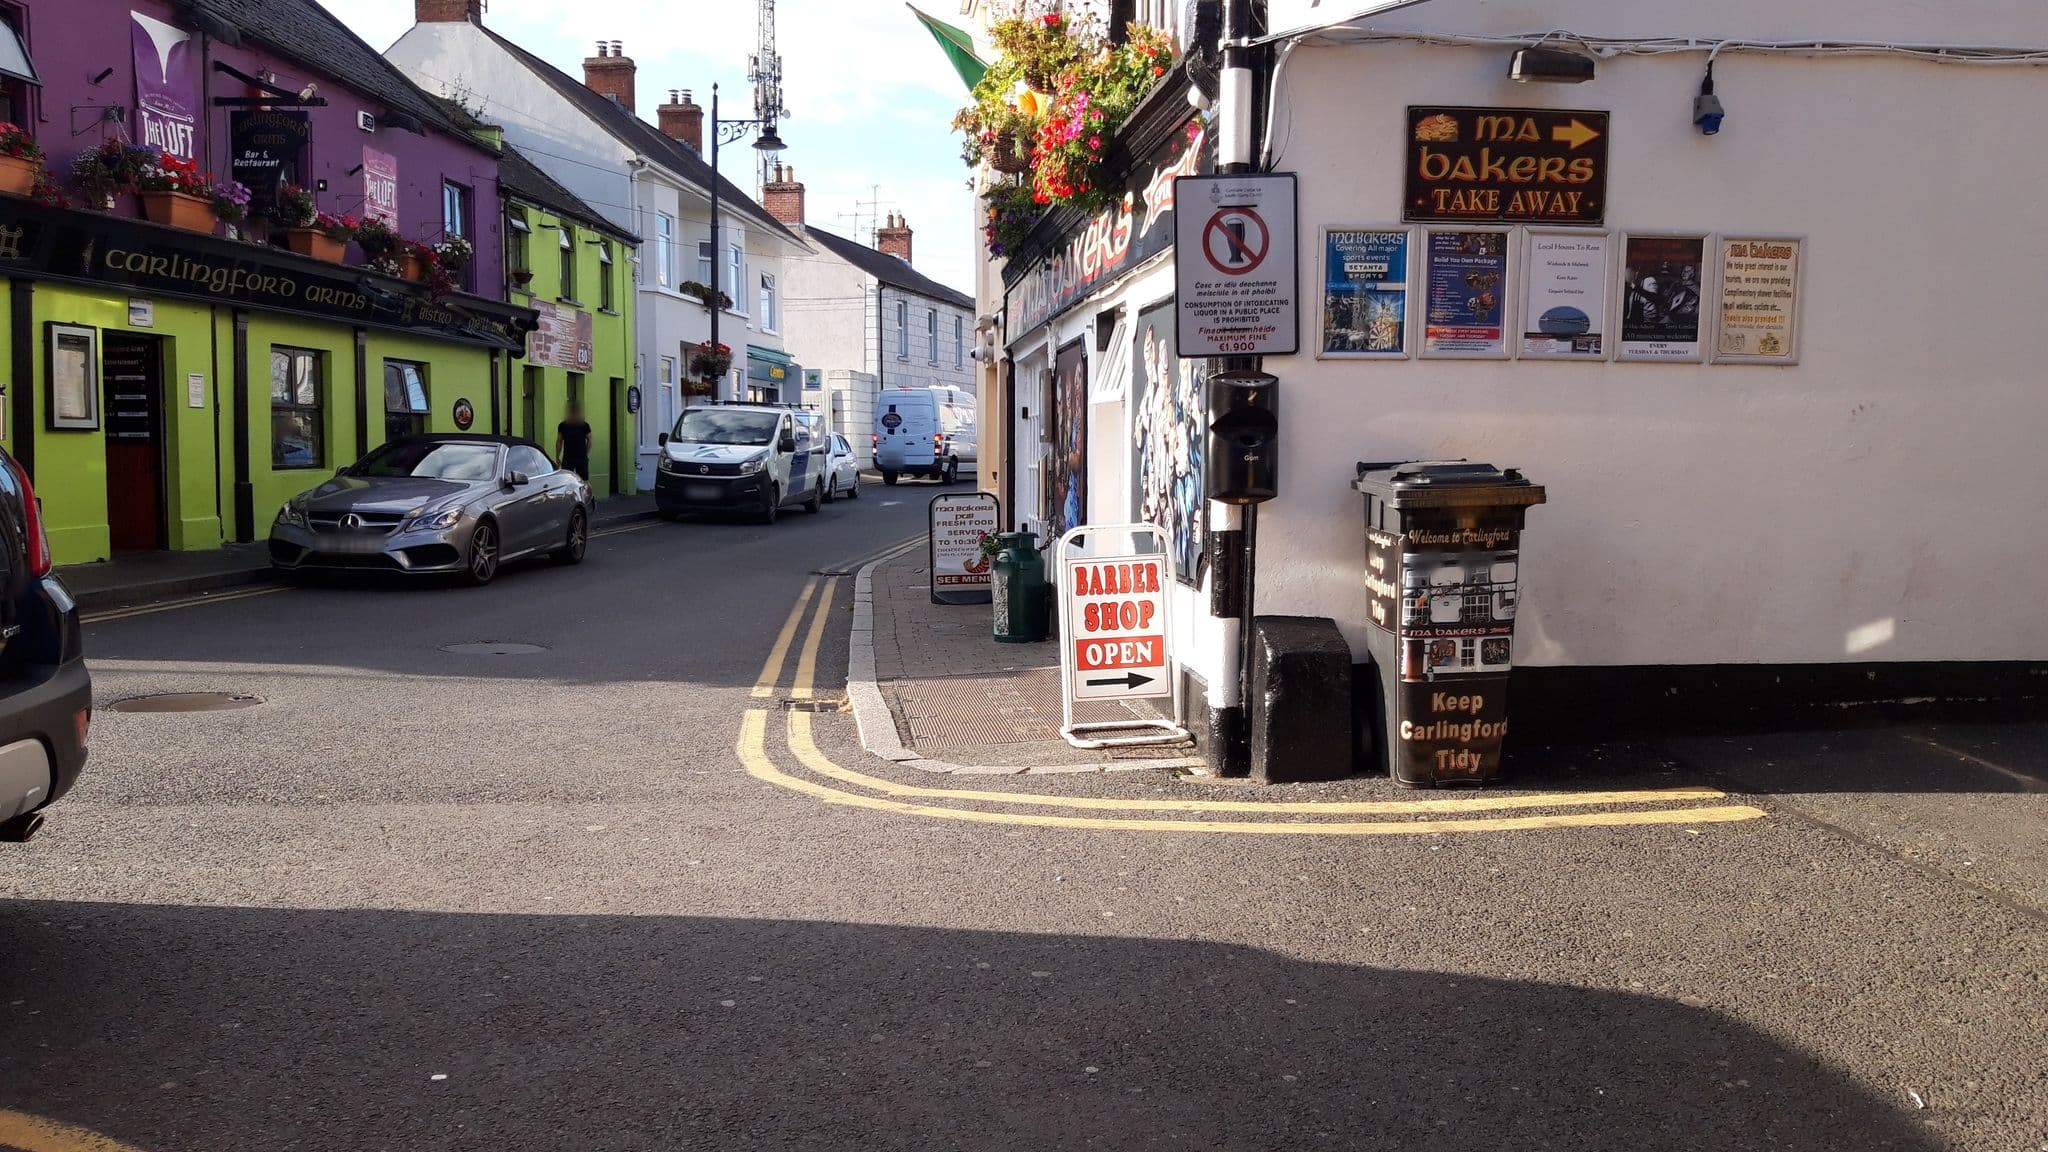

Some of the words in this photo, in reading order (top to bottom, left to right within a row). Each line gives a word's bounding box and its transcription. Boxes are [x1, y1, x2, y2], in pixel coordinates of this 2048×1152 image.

[245, 150, 260, 158] Bar
[263, 150, 270, 158] &
[234, 158, 280, 168] Restaurant
[1432, 188, 1500, 214] TAKE
[1507, 190, 1583, 215] AWAY
[1335, 244, 1366, 252] Covering
[1744, 263, 1757, 272] great
[1771, 276, 1791, 286] providing
[1184, 301, 1232, 309] CONSUMPTION
[1234, 300, 1242, 308] OF
[1244, 299, 1289, 307] INTOXICATING
[1194, 309, 1218, 317] LIQUOR
[1235, 308, 1258, 316] PUBLIC
[1222, 315, 1260, 324] PROHIBITED
[1755, 315, 1777, 323] provided
[1207, 334, 1247, 343] MAXIMUM
[1249, 333, 1267, 341] FINE
[1408, 529, 1450, 545] Welcome
[1452, 530, 1460, 542] to
[1462, 527, 1510, 548] Carlingford
[937, 576, 959, 584] SEE
[1075, 562, 1160, 597] BARBER
[1084, 600, 1155, 632] SHOP
[1085, 641, 1154, 666] OPEN
[1432, 691, 1484, 714] Keep
[1400, 717, 1508, 742] Carlingford
[1436, 748, 1481, 773] Tidy
